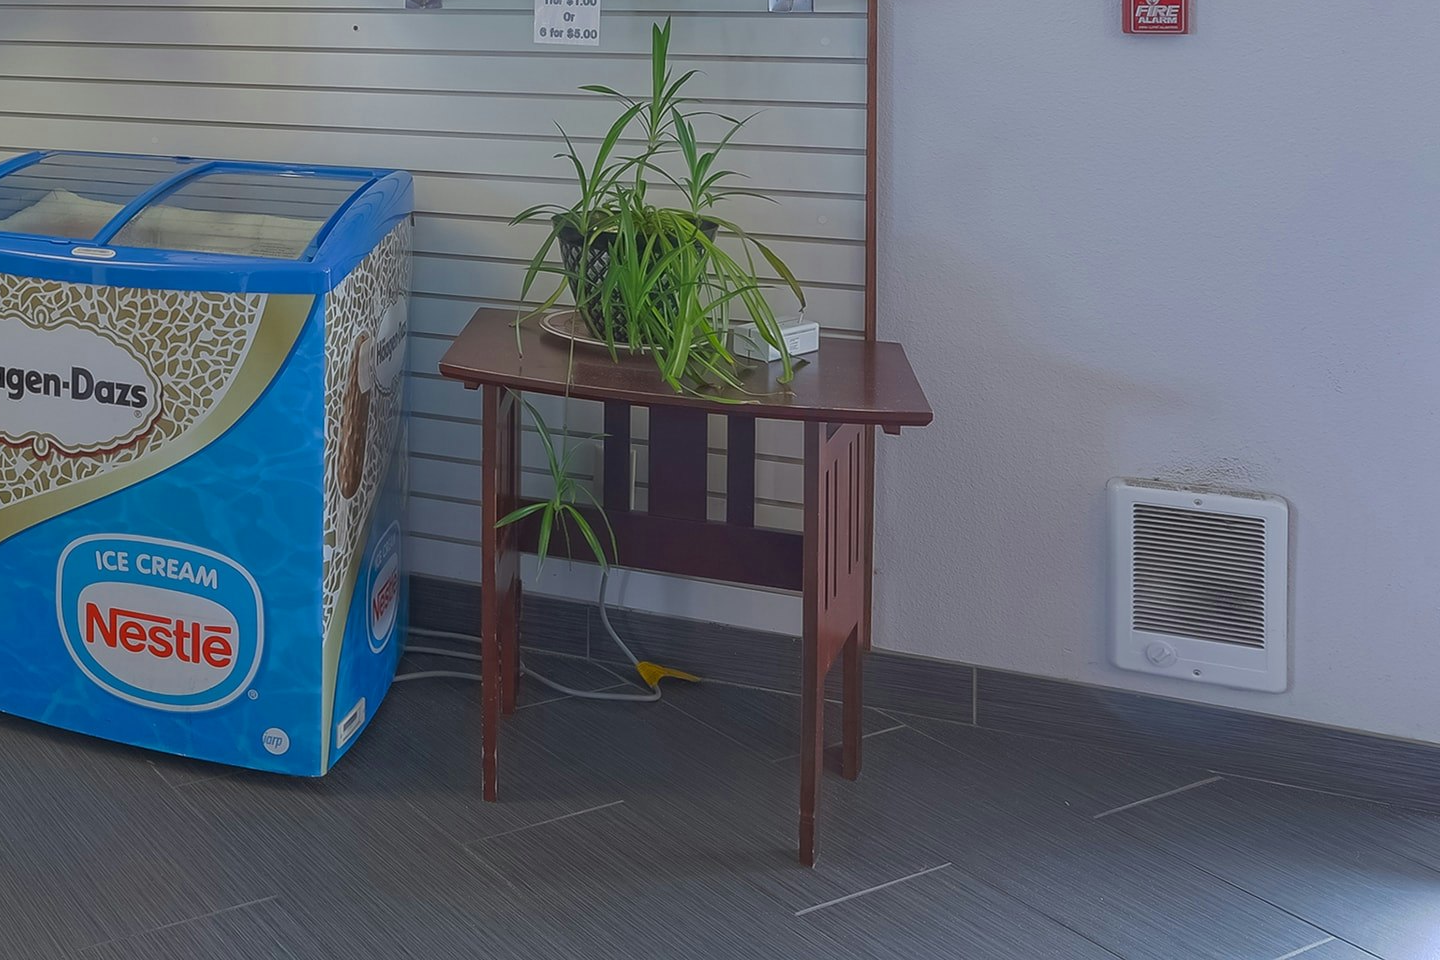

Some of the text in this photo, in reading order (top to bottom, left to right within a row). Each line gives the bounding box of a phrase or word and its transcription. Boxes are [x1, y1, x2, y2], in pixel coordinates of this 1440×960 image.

[1135, 5, 1180, 17] FIRE
[563, 12, 575, 22] Or
[1138, 16, 1177, 24] ALARM
[550, 28, 563, 37] for
[567, 28, 597, 39] $5.00
[95, 550, 218, 590] ICE CREAM
